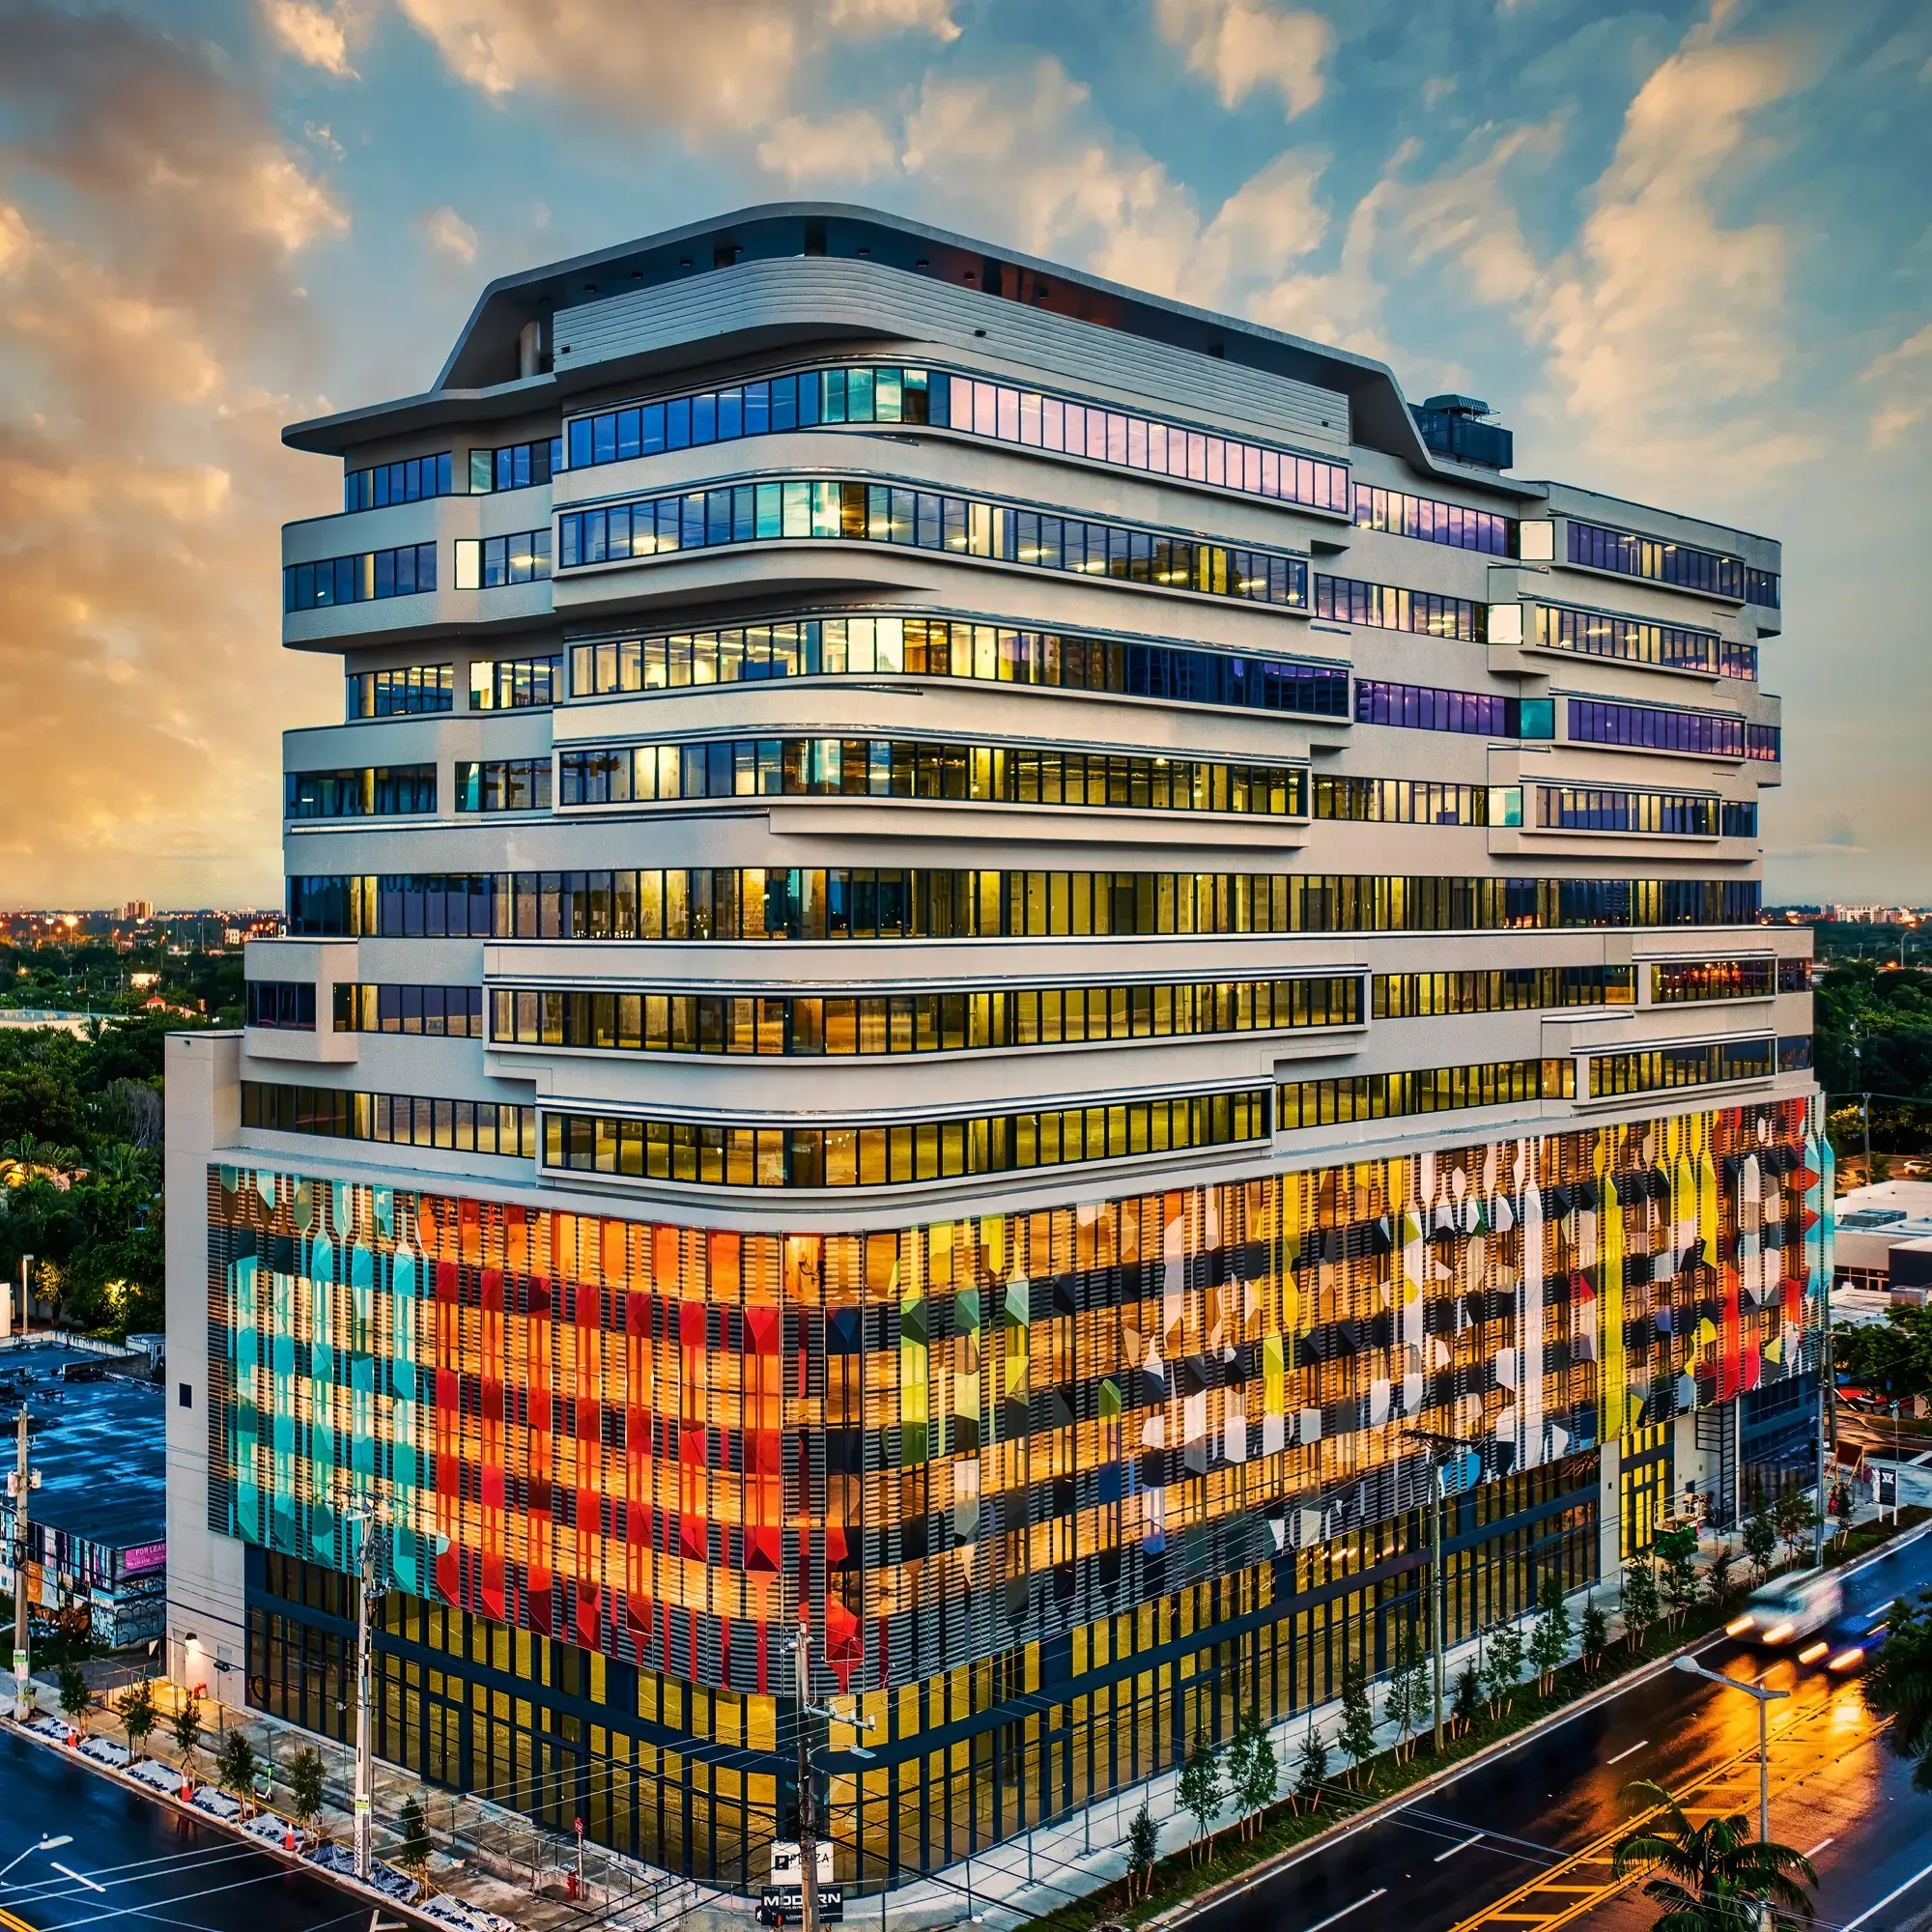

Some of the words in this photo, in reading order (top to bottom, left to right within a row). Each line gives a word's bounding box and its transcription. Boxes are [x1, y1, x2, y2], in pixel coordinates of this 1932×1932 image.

[150, 1544, 166, 1553] LEAS
[790, 1853, 830, 1865] PLZA
[764, 1893, 840, 1906] MODRN
